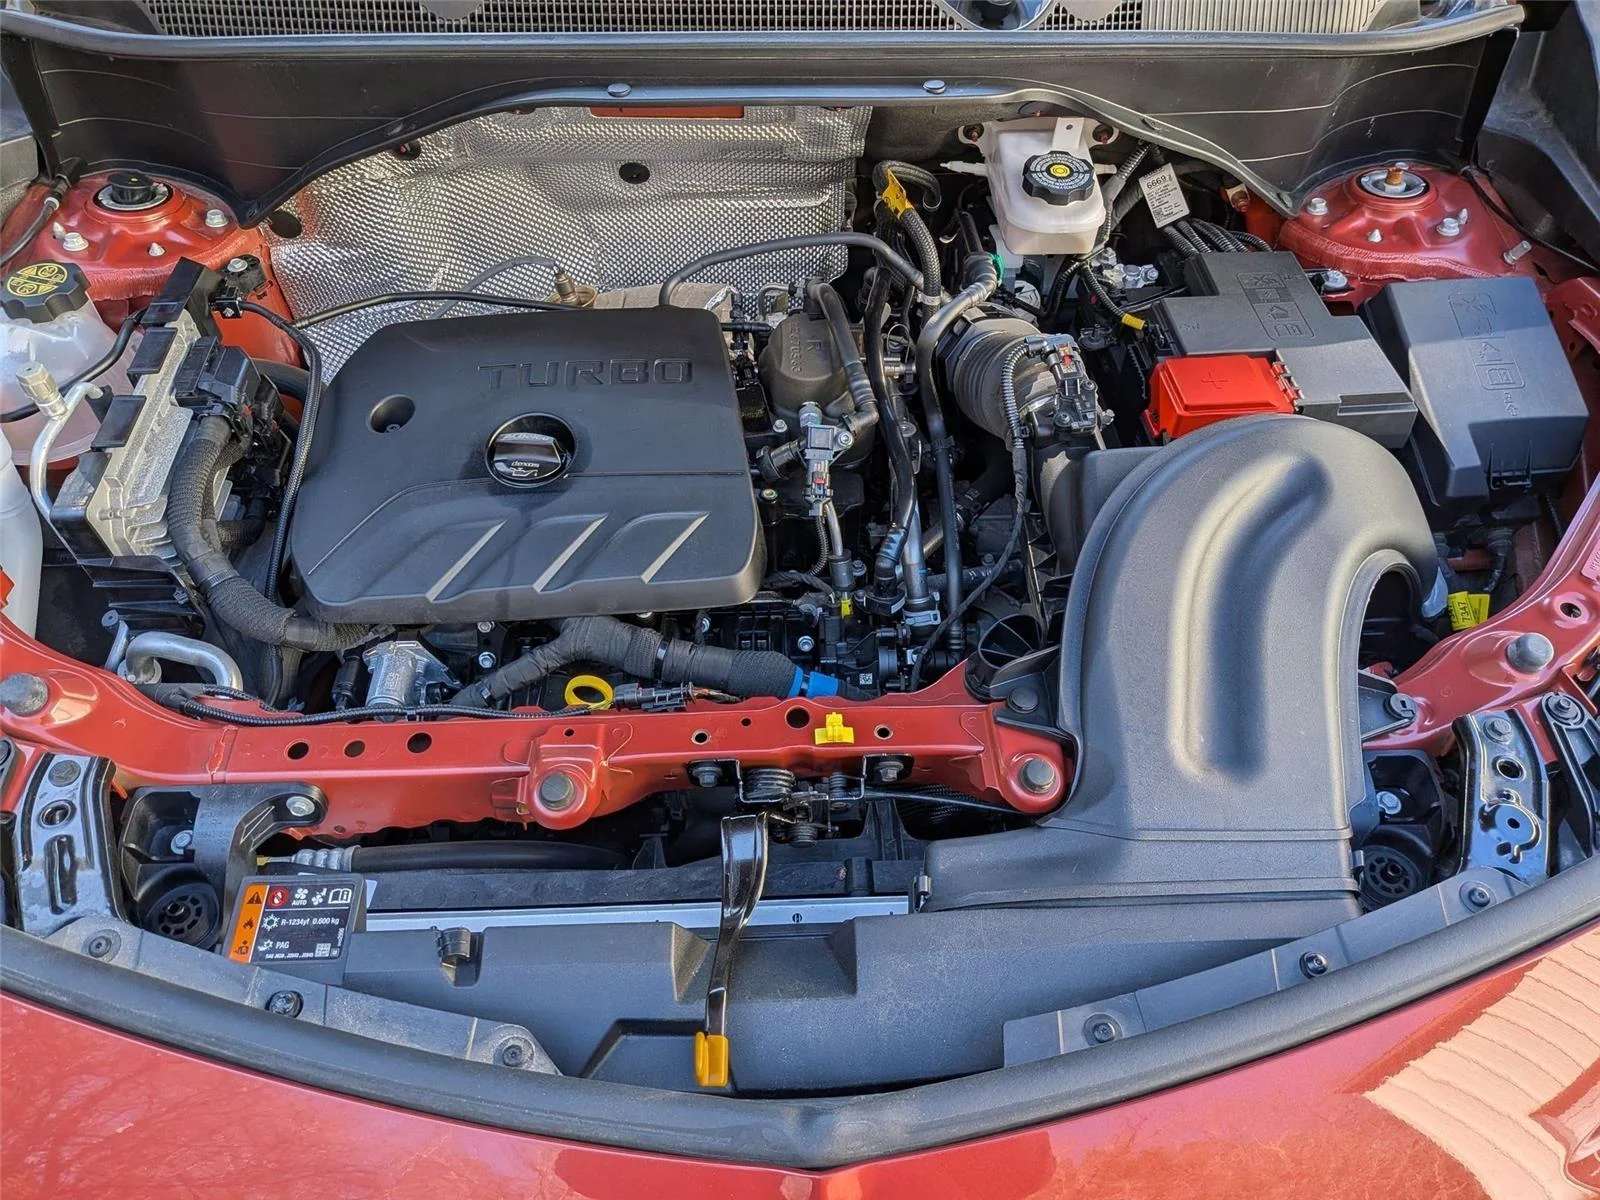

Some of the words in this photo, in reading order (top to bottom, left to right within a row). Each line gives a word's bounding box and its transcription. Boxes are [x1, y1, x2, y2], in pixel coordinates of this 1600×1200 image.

[1147, 175, 1167, 189] 6669
[477, 358, 694, 390] TURBO
[511, 460, 540, 468] dexos
[1457, 601, 1471, 623] 7347
[281, 918, 310, 926] R-1234yf
[331, 917, 340, 925] kg
[275, 941, 290, 949] PAG
